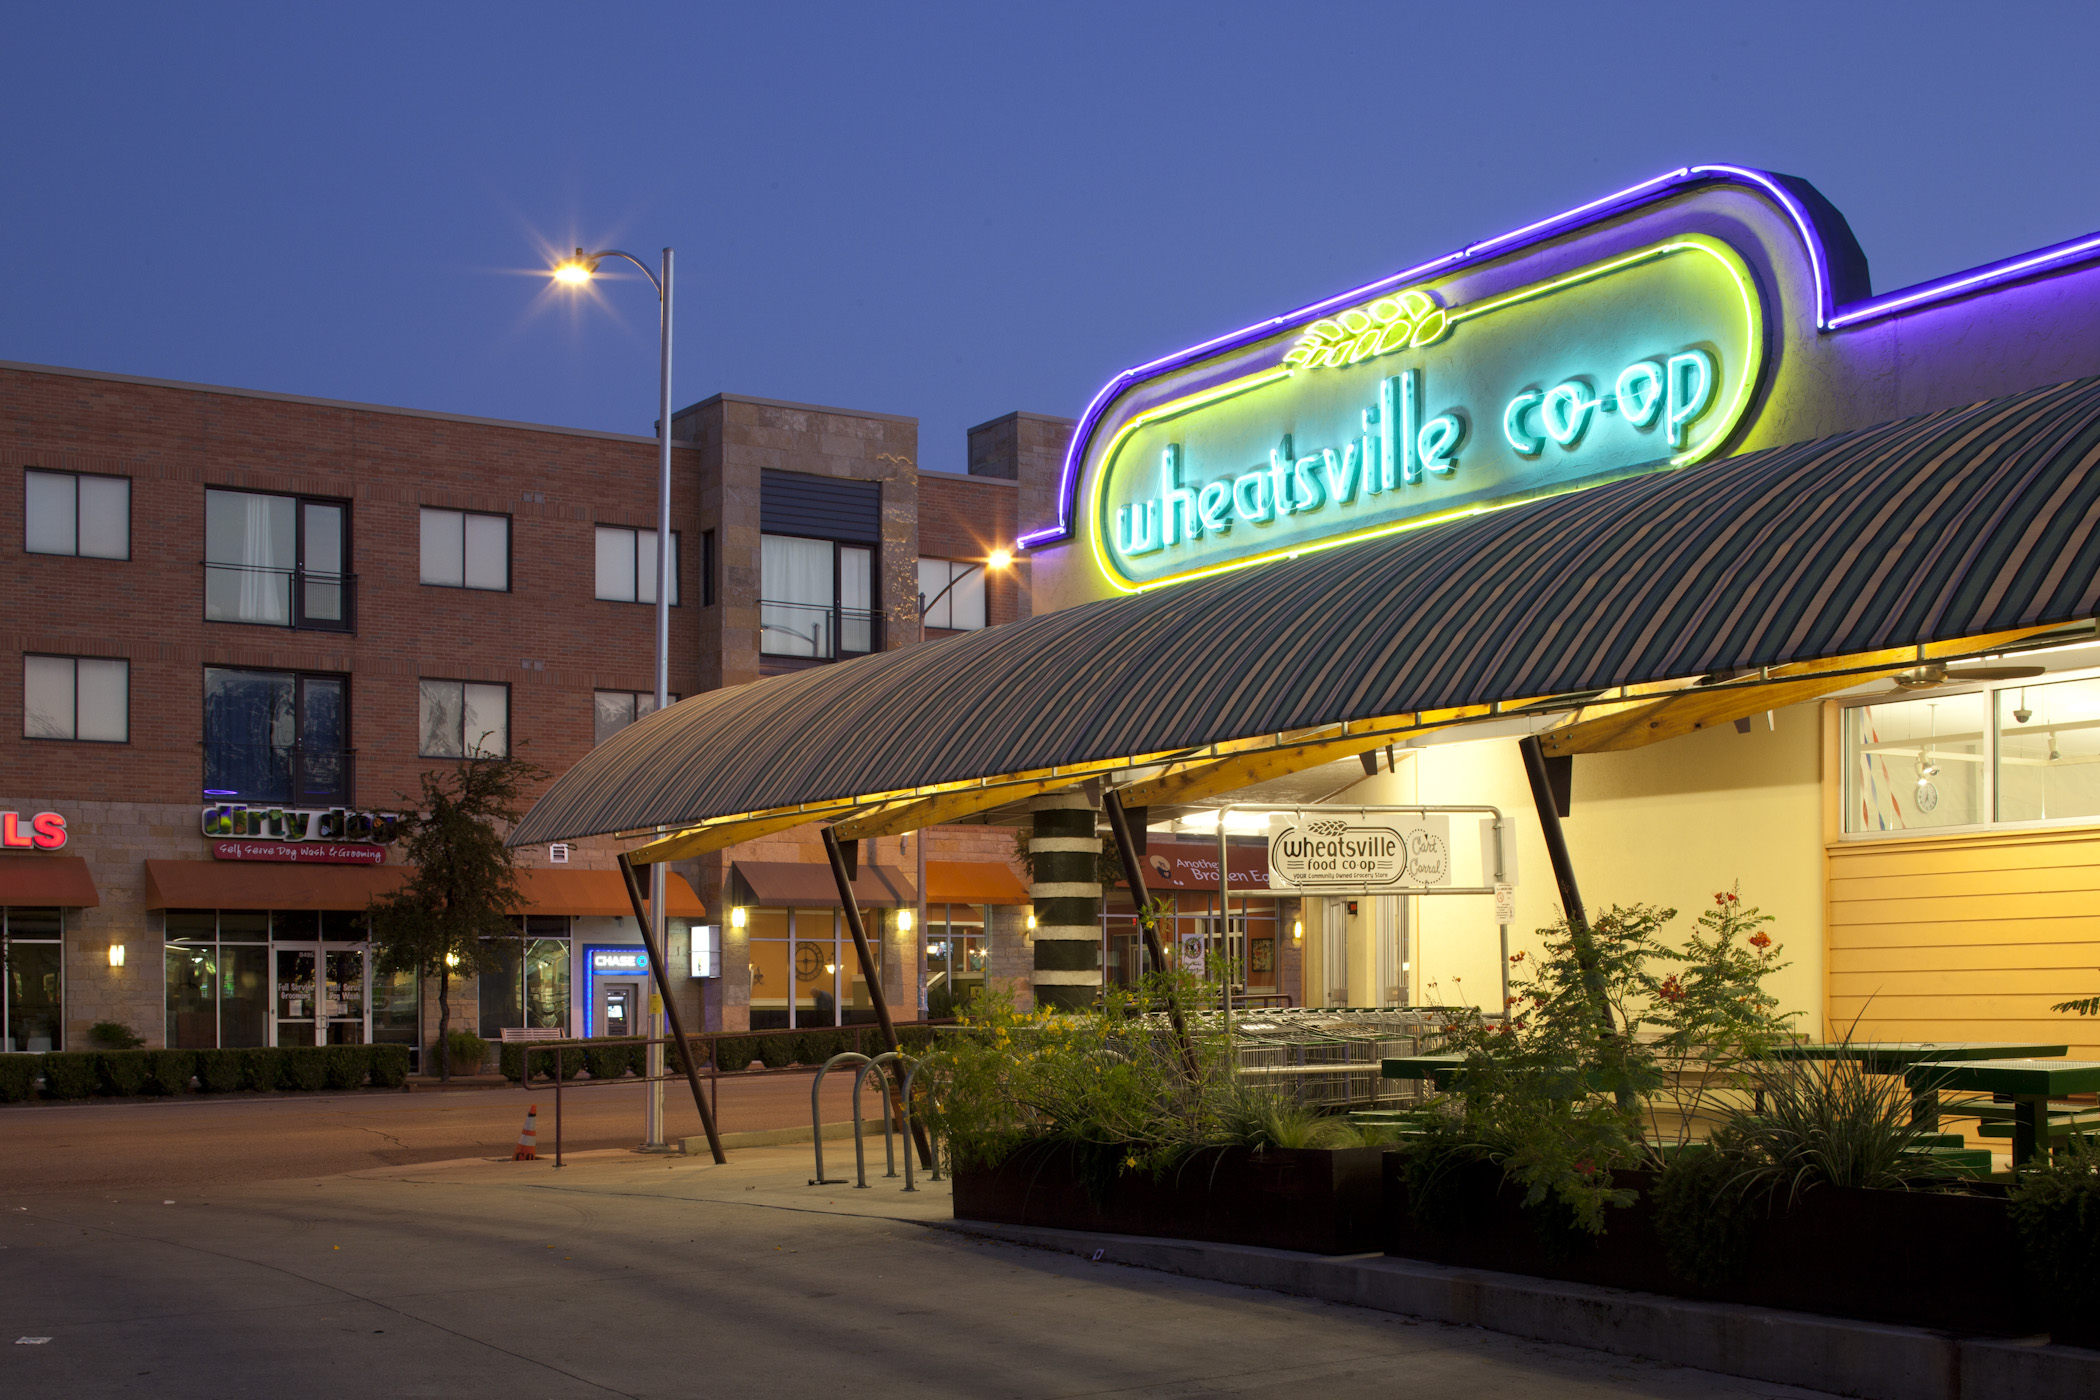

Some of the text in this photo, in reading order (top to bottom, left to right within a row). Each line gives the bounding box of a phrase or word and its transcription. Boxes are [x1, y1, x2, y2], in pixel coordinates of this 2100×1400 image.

[1116, 348, 1720, 555] wheatsville co-op
[4, 813, 66, 848] LS
[205, 805, 400, 843] dirty dog
[219, 844, 242, 857] Self
[244, 844, 274, 855] Serve
[276, 847, 297, 860] Dog
[300, 848, 325, 857] Wash
[338, 849, 382, 862] Grooming
[1283, 836, 1396, 858] wheatsville
[1411, 836, 1438, 856] Cart
[1176, 858, 1220, 869] Anothe
[1307, 858, 1336, 871] food
[1409, 858, 1441, 877] Corral
[1190, 867, 1270, 885] Broen Eg
[1353, 872, 1374, 880] Grocery
[594, 955, 636, 967] CHASE
[278, 983, 289, 991] Full
[281, 992, 311, 1000] Grooming
[329, 992, 361, 1000] Dog Wash
